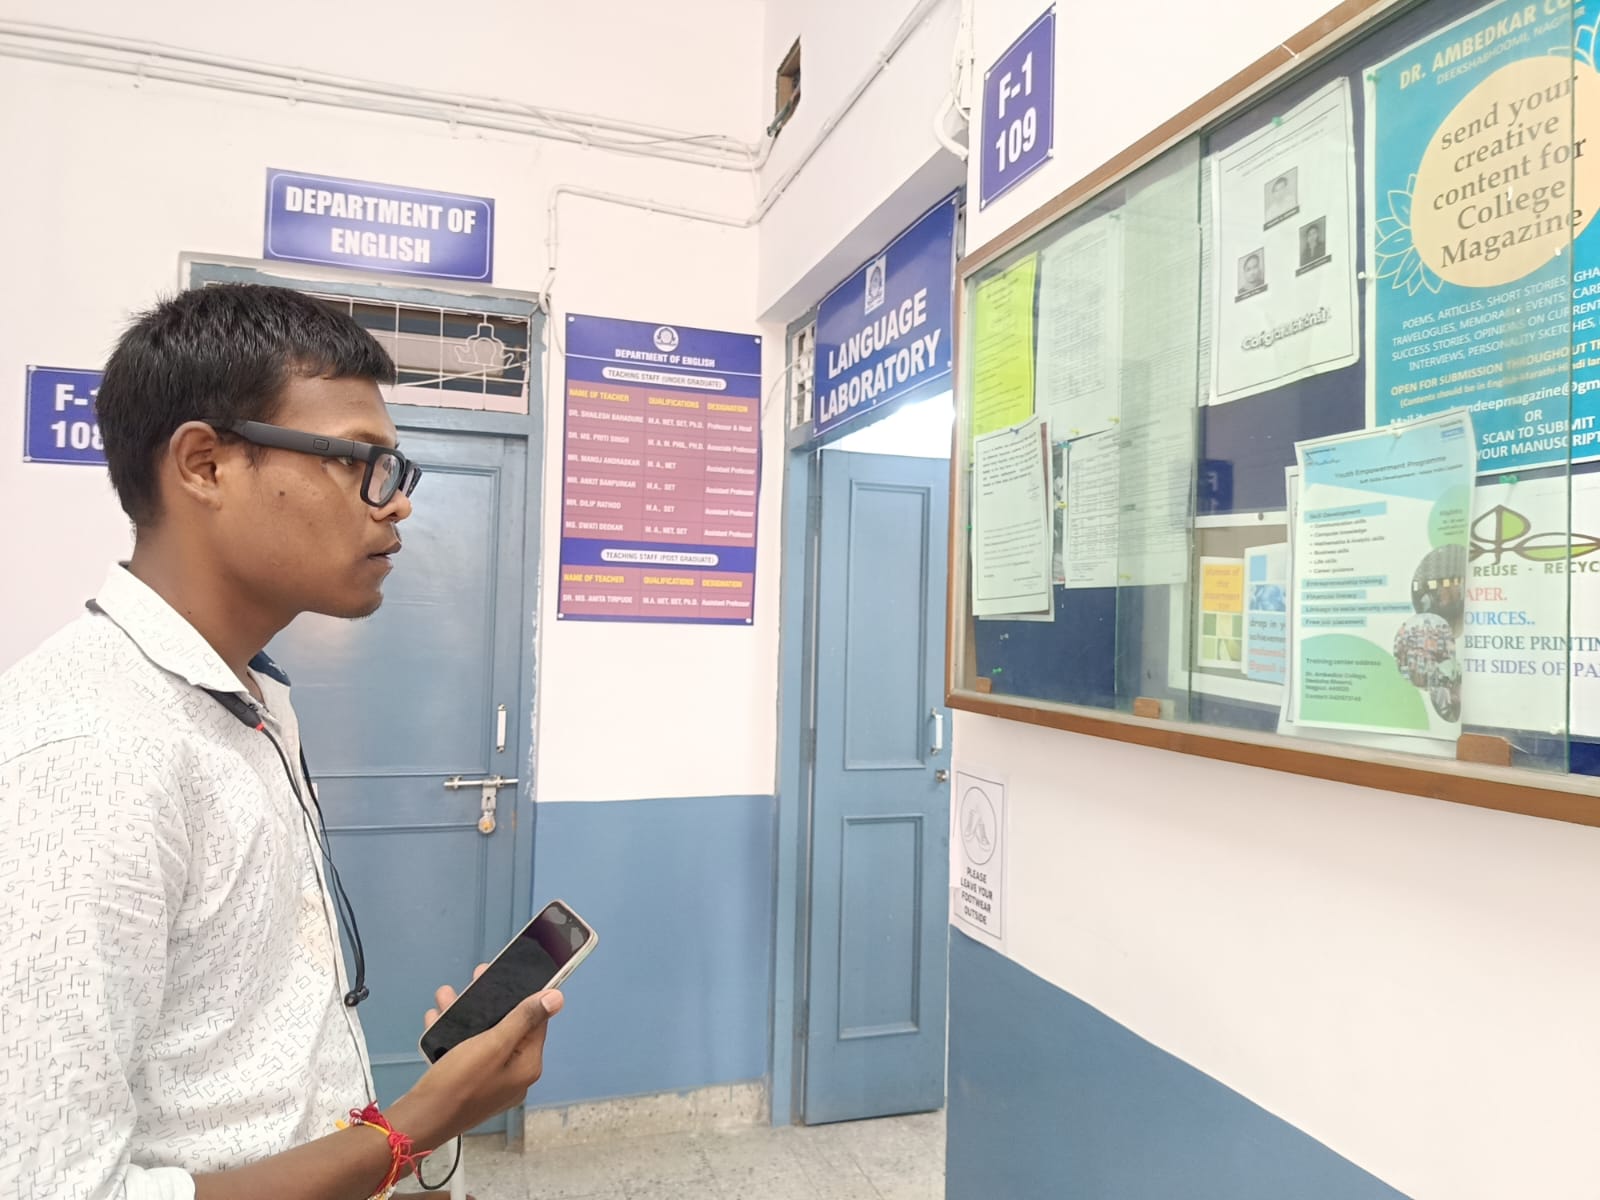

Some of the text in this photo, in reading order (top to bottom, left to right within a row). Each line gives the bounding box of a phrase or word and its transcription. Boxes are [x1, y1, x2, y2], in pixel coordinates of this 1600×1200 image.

[1400, 4, 1537, 90] DR. AMBEDKAR
[998, 52, 1033, 119] F-1
[1441, 74, 1579, 151] send your
[995, 107, 1037, 173] 109
[1453, 114, 1560, 174] creative
[1432, 137, 1587, 211] content for
[285, 186, 477, 234] DEPARTMENT OF
[1457, 179, 1567, 231] College
[331, 227, 431, 264] ENGLISH
[1440, 207, 1584, 269] Magazine
[1486, 291, 1521, 307] SHORT
[828, 288, 927, 380] LANGUAGE
[1391, 344, 1431, 362] SUCCESS
[1527, 314, 1546, 327] ON
[1467, 330, 1537, 357] PERSONALITY
[615, 349, 715, 368] DEPARTMENT OF ENGLISH
[608, 369, 640, 380] TEACHING
[641, 373, 660, 382] STAFF
[820, 329, 941, 424] LABORATORY
[1391, 382, 1418, 396] OPEN
[1419, 377, 1438, 390] FOR
[1439, 364, 1504, 386] SUBMISSION
[55, 383, 101, 411] F-
[569, 389, 588, 398] NAME
[590, 391, 598, 399] OF
[600, 391, 629, 402] TEACHER
[648, 397, 699, 409] QUALIFICATIONS
[1524, 409, 1543, 423] OR
[1482, 429, 1515, 446] SCAN
[1518, 425, 1534, 439] TO
[1537, 415, 1596, 437] SUBMIT
[1355, 463, 1406, 477] Empowerment
[1322, 509, 1361, 519] Development
[606, 551, 639, 560] TEACHING
[640, 553, 659, 561] STAFF
[564, 574, 583, 582] NAME
[584, 574, 593, 583] OF
[594, 575, 625, 584] TEACHER
[643, 576, 695, 587] QUALIFICATIONS
[1472, 564, 1518, 577] REUSE
[1464, 635, 1525, 650] BEFORE
[1491, 659, 1537, 676] SIDES
[1542, 661, 1567, 677] OF
[960, 877, 993, 901] LEAVE YOUR
[966, 866, 988, 885] PLEASE
[961, 890, 992, 914] FOOTWEAR
[964, 905, 988, 926] OUTSIDE
